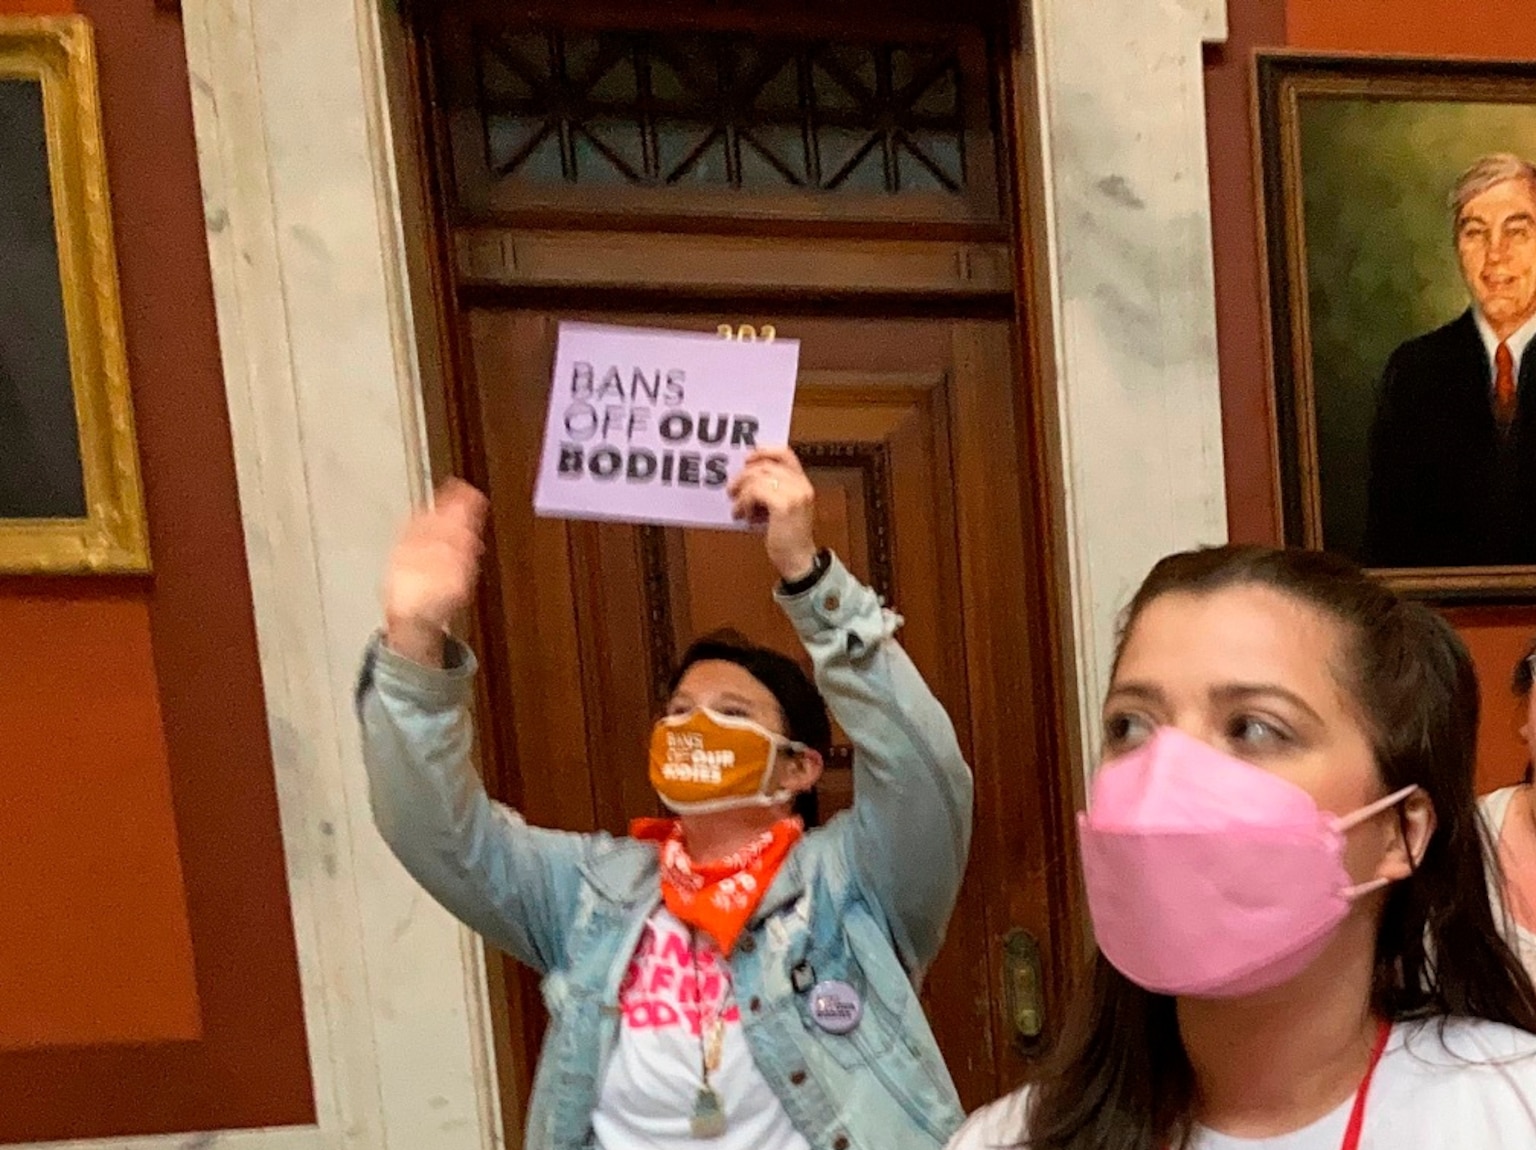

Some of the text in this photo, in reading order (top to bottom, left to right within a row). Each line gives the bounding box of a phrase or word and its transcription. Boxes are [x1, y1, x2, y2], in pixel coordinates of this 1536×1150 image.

[570, 361, 686, 406] BANS
[563, 399, 759, 450] OFF OUR
[557, 441, 728, 488] BODIES
